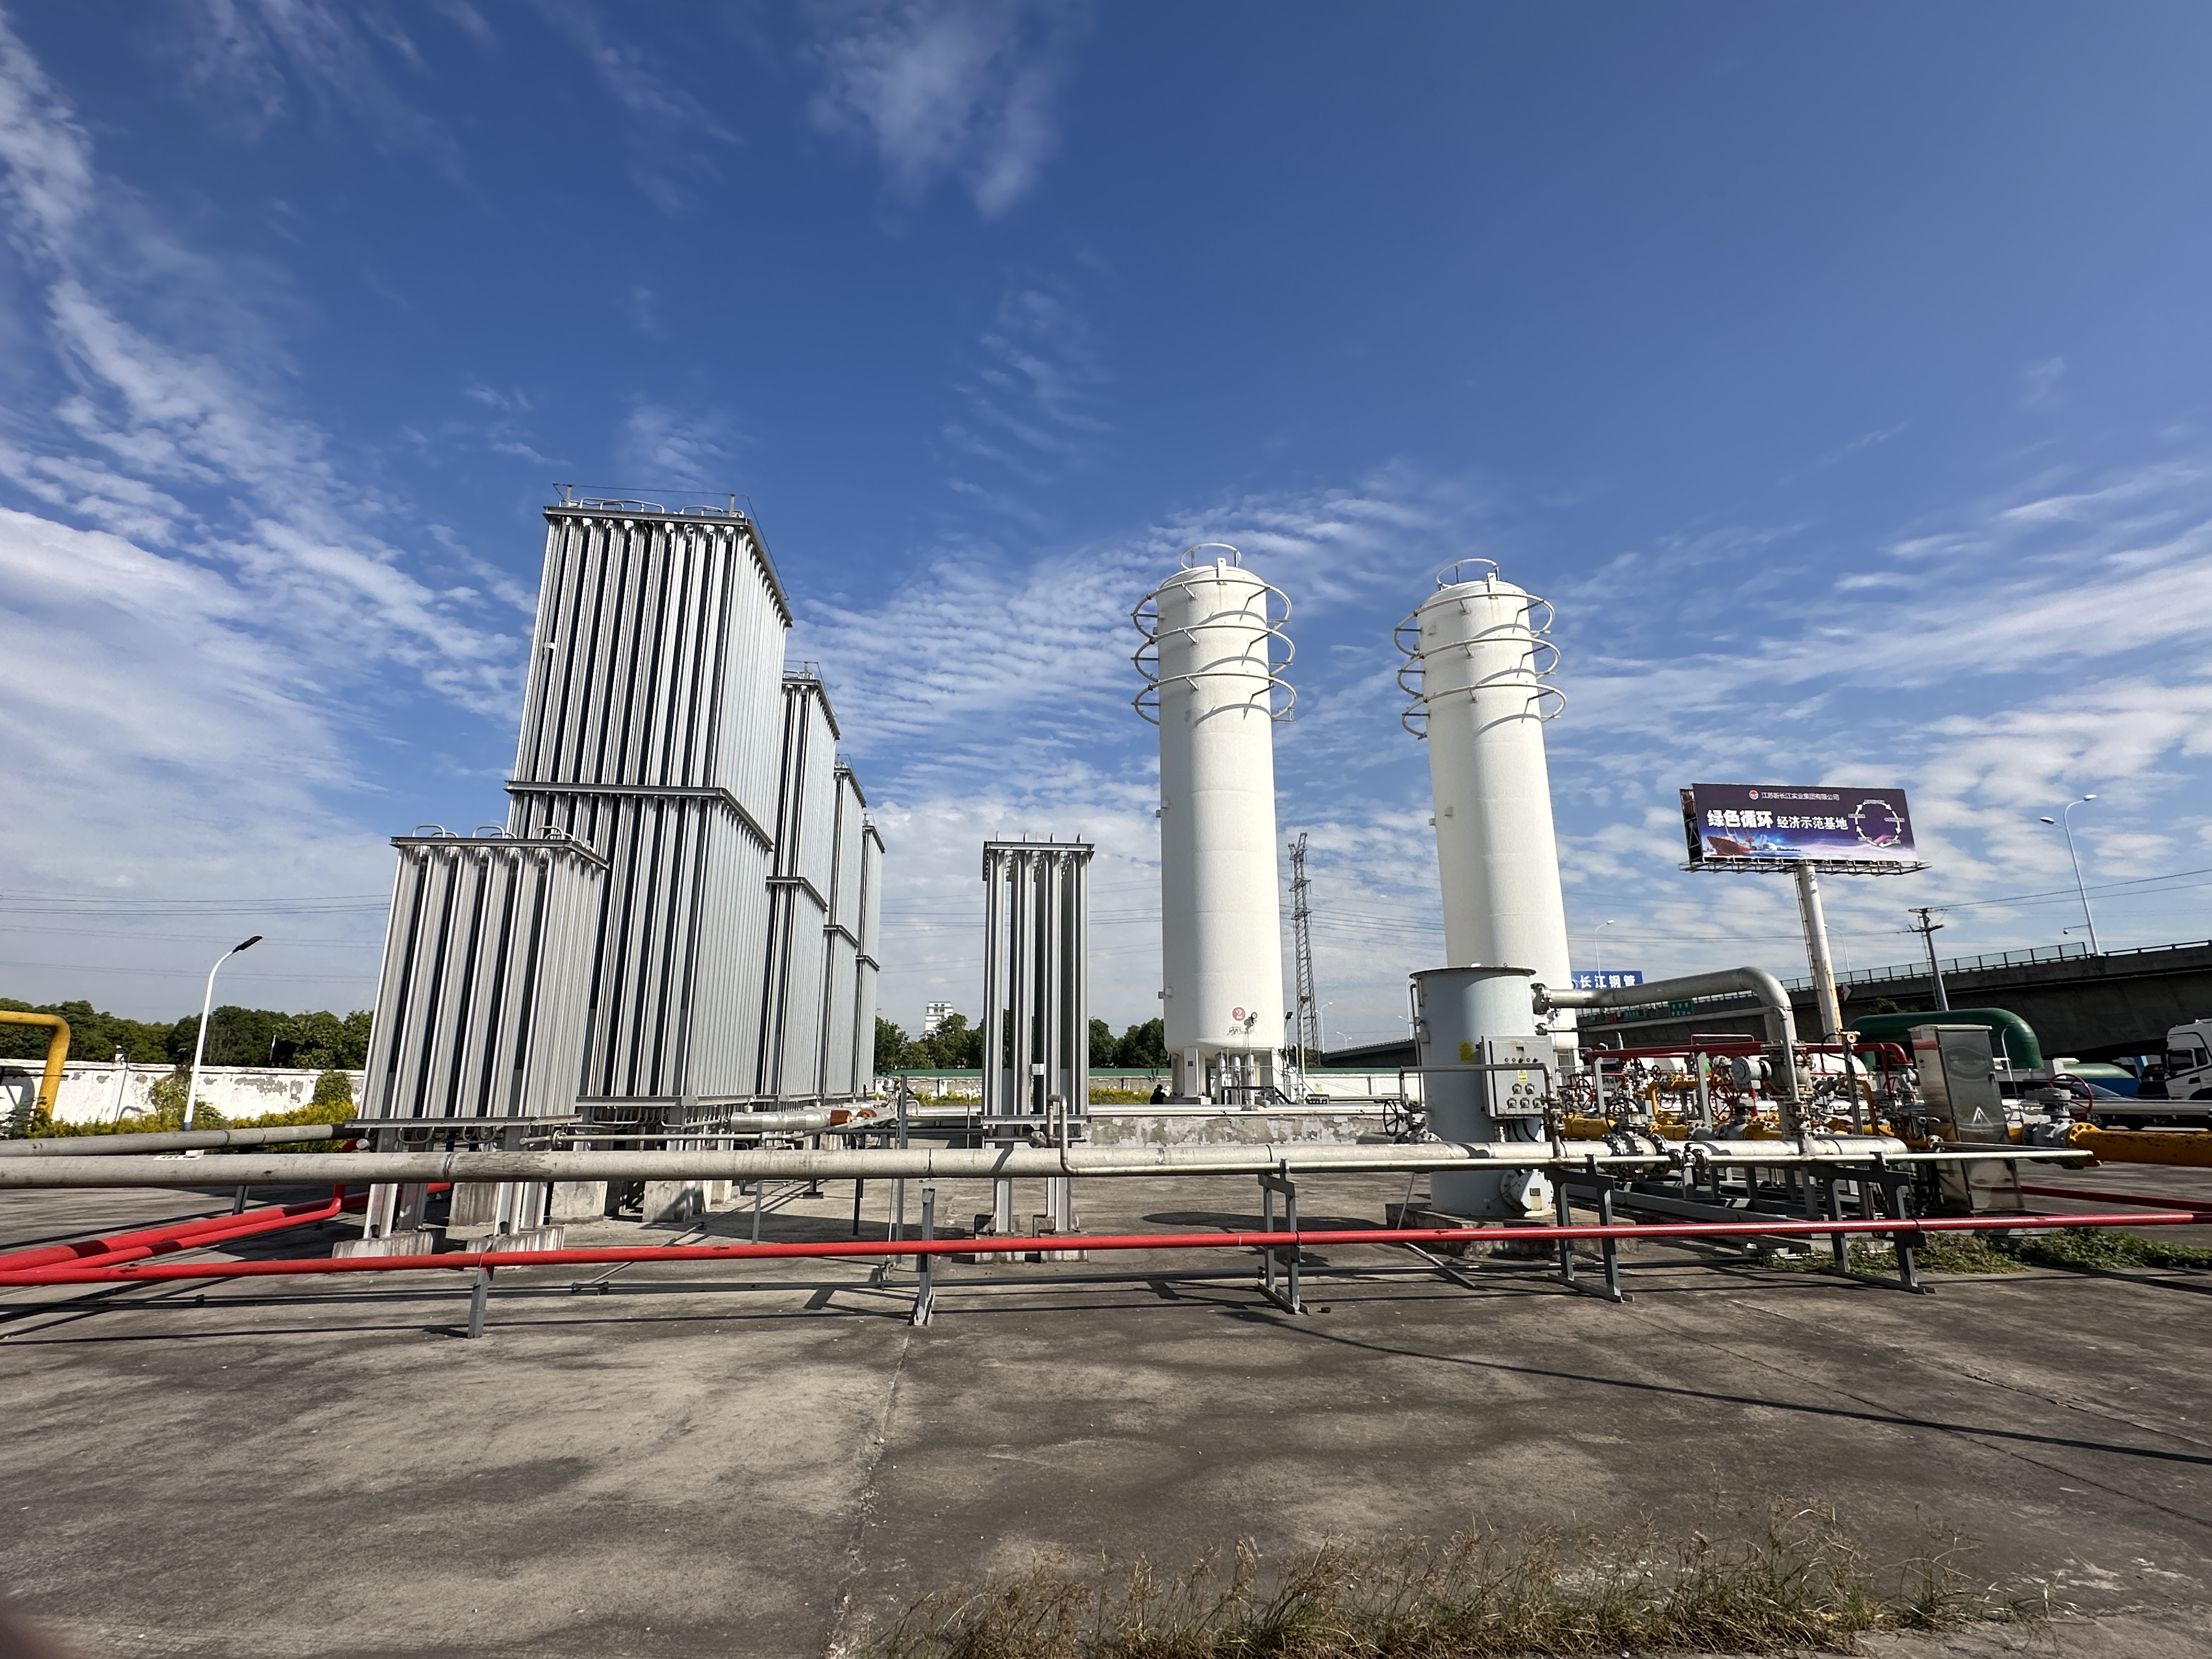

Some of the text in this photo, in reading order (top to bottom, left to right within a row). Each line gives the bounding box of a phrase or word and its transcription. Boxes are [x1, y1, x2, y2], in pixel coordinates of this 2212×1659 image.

[1706, 809, 1849, 830] 绿色循环 经济示范基地
[1580, 974, 1635, 989] 长江钢管
[1235, 1009, 1243, 1019] 2
